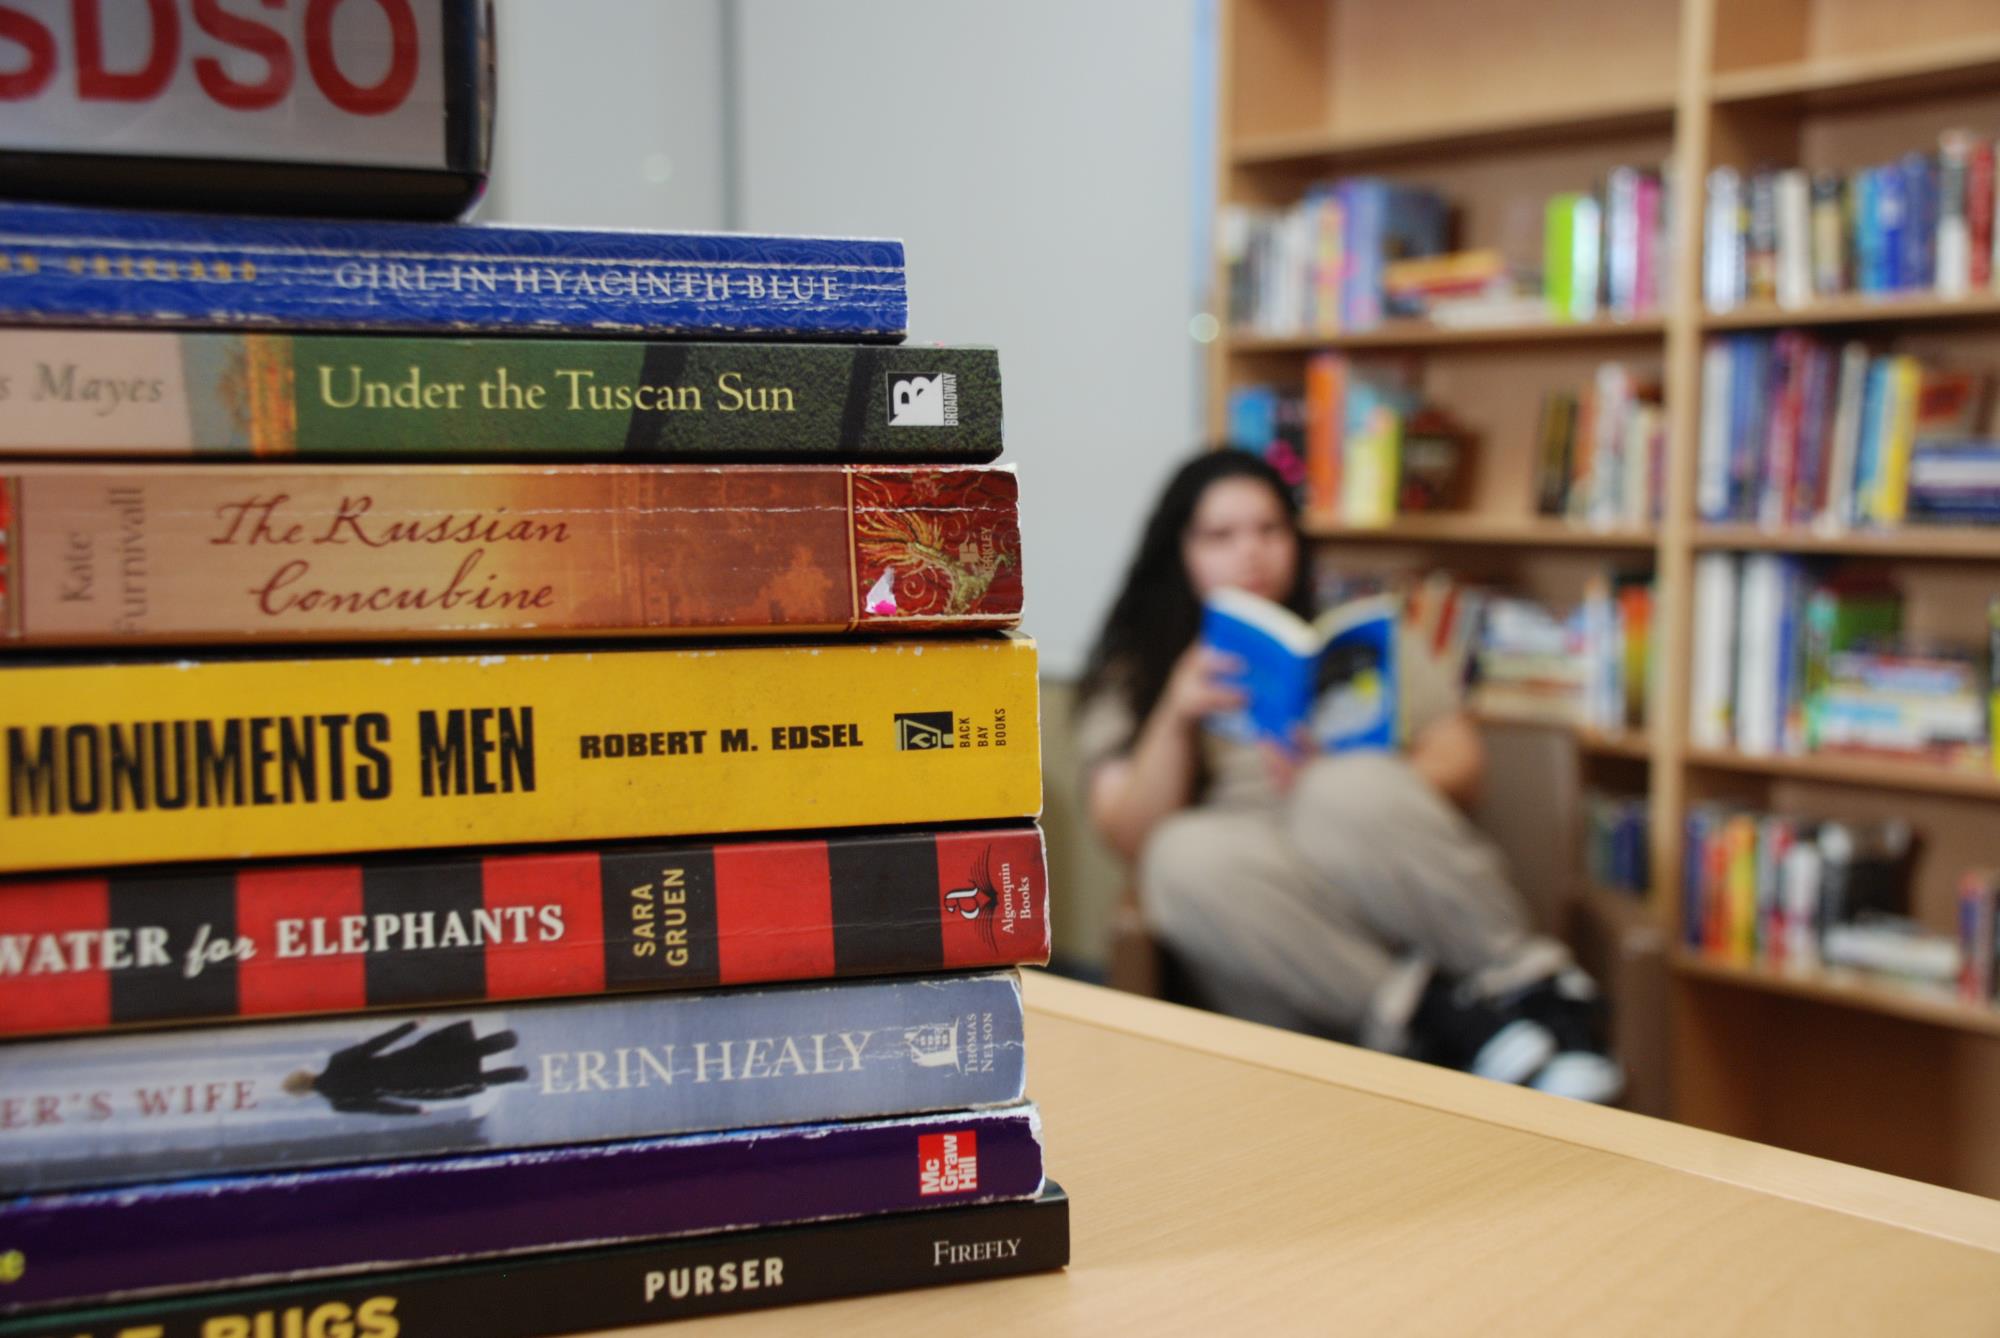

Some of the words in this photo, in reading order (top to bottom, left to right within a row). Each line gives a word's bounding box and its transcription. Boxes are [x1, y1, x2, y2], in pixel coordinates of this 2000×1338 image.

[335, 262, 438, 290] GIRL
[449, 265, 498, 291] IN
[513, 268, 730, 299] HYACINTH
[747, 275, 840, 301] BLUE
[32, 362, 164, 417] Mayes
[318, 365, 465, 410] Under
[480, 368, 546, 411] the
[554, 370, 702, 412] Tuscan
[717, 373, 796, 413] Sun
[943, 372, 959, 426] BROADWAY
[209, 492, 304, 546] The
[312, 494, 571, 548] Russian
[61, 531, 95, 602] Kate
[248, 548, 554, 616] Concubine
[580, 730, 707, 759] ROBERT
[720, 728, 759, 753] M.
[771, 723, 863, 751] EDSEL
[959, 717, 971, 748] BACK
[977, 726, 989, 747] BAY
[994, 707, 1007, 746] BOOKS
[7, 712, 392, 817] MONUMENTS
[418, 706, 536, 797] MEN
[632, 882, 655, 957] SARA
[663, 867, 689, 967] GRUEN
[999, 863, 1017, 935] Algonquin
[1018, 876, 1032, 919] Books
[0, 926, 172, 976] WATER
[183, 923, 257, 978] for
[275, 904, 565, 958] ELEPHANTS
[540, 1044, 674, 1095] ERIN
[692, 1030, 872, 1083] HEALY
[964, 1012, 979, 1076] THOMAS
[980, 1012, 994, 1073] NELSON
[134, 1079, 258, 1117] WIFE
[920, 1157, 941, 1195] Mc
[940, 1133, 959, 1193] Graw
[958, 1156, 977, 1190] Hill
[932, 1236, 1021, 1267] FIREFLY
[645, 1257, 785, 1302] PURSER
